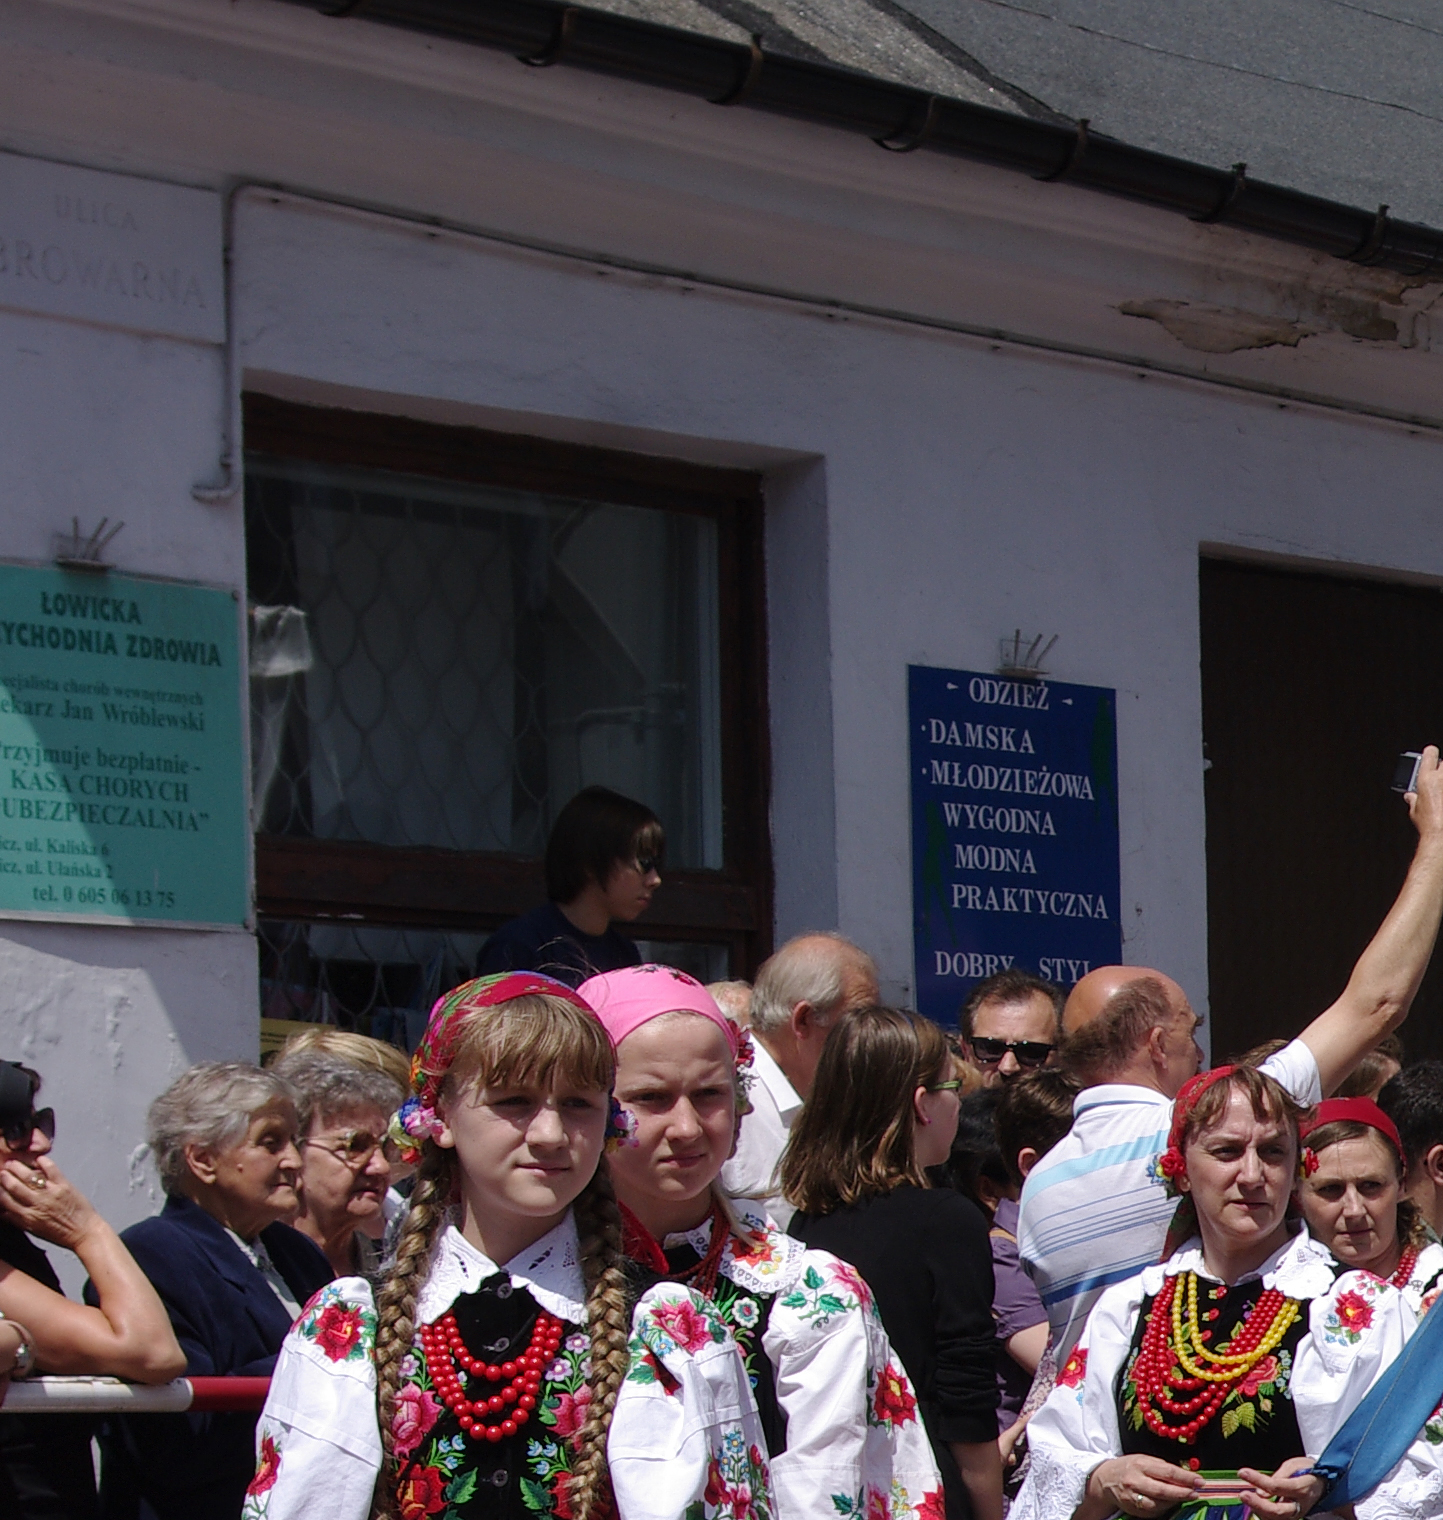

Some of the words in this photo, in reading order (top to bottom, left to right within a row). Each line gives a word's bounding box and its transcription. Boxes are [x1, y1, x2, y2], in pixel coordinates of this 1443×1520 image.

[54, 194, 139, 231] ULICA
[41, 591, 143, 625] ŁOWICKA
[126, 634, 222, 668] ZDROWIA
[969, 677, 1050, 711] ODZIEŻ
[61, 699, 93, 721] Jan
[102, 701, 204, 731] Wróblewski
[929, 718, 1035, 755] DAMSKA
[0, 741, 91, 770] rzyjmuje
[11, 769, 74, 794] KASA
[79, 773, 189, 803] CHORYCH
[930, 759, 1095, 801] MŁODZIEŻOWA
[943, 802, 1057, 836] WYGODNA
[954, 843, 1037, 875] MODNA
[33, 885, 57, 902] tel.
[63, 886, 72, 901] 0
[78, 886, 106, 904] 605
[157, 891, 175, 908] 75
[951, 883, 1109, 920] PRAKTYCZNA
